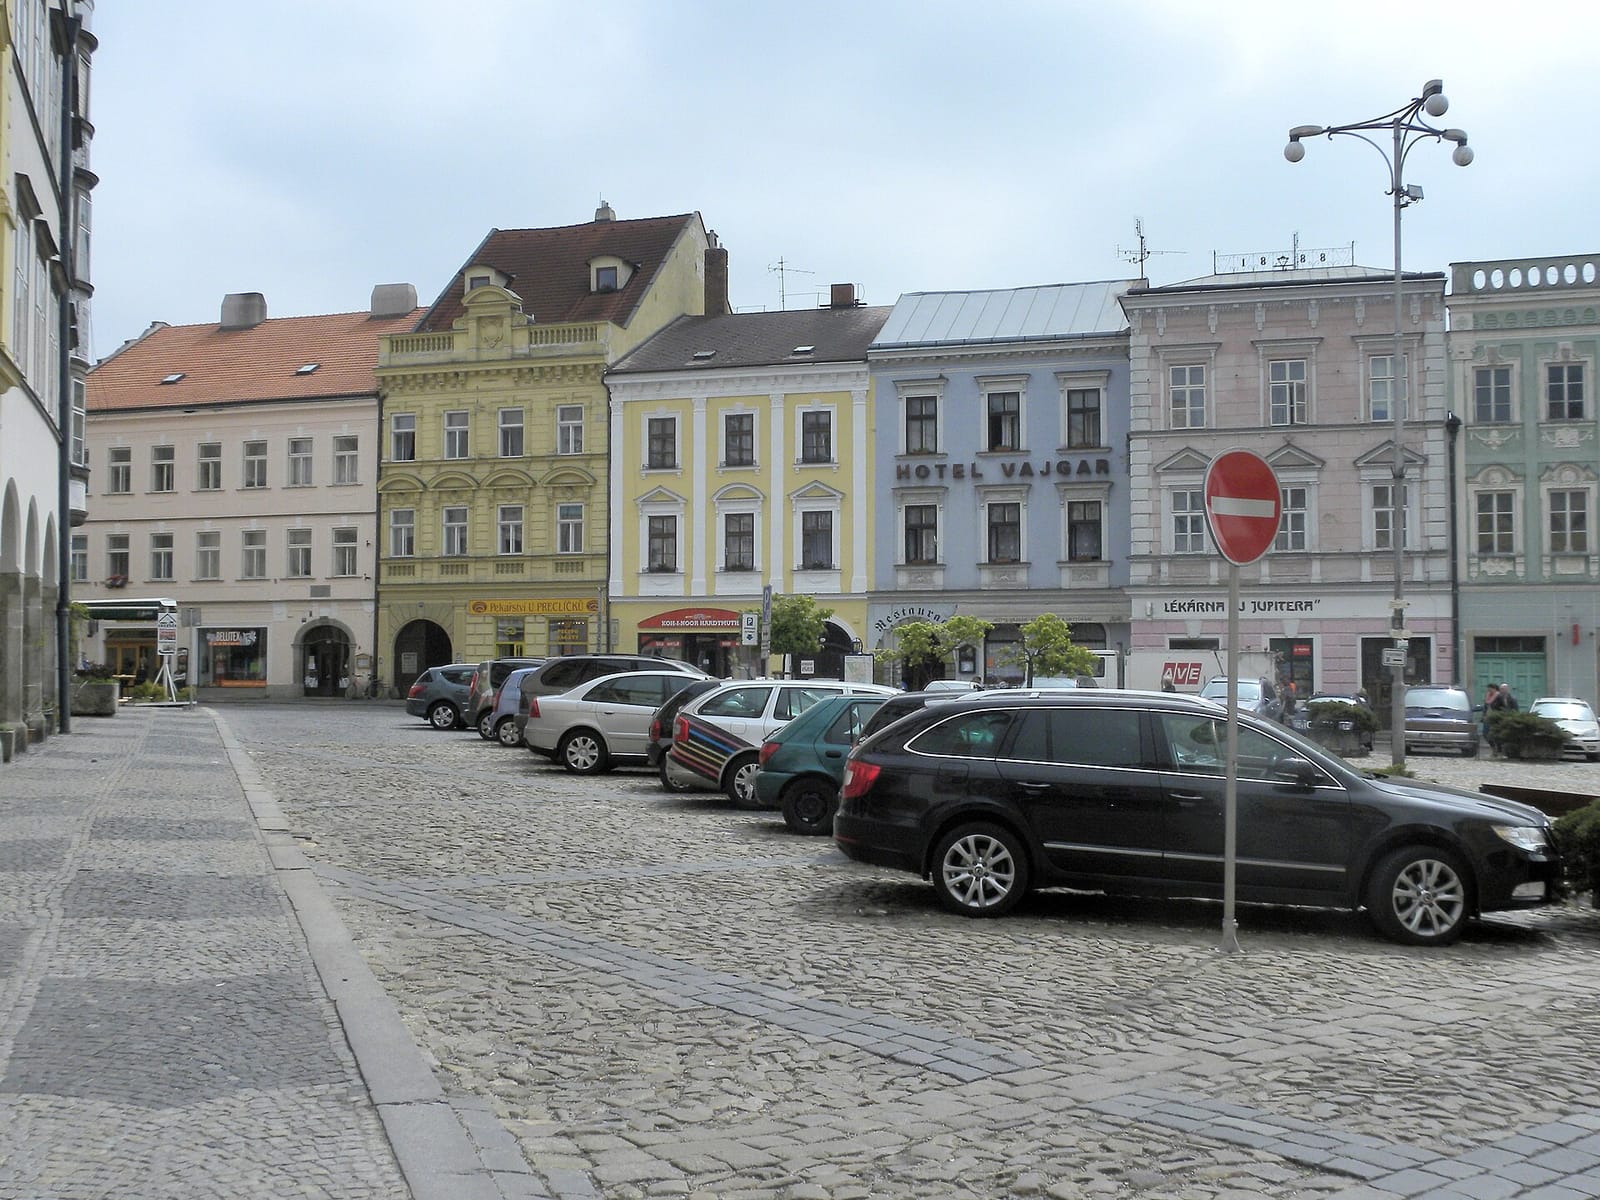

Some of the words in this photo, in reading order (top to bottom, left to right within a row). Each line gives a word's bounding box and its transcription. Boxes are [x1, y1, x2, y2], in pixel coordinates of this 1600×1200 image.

[896, 463, 983, 480] HOTEL
[1001, 459, 1110, 478] VAJGAR
[1164, 600, 1225, 613] LÉKÁRNA
[1163, 667, 1201, 681] AVE
